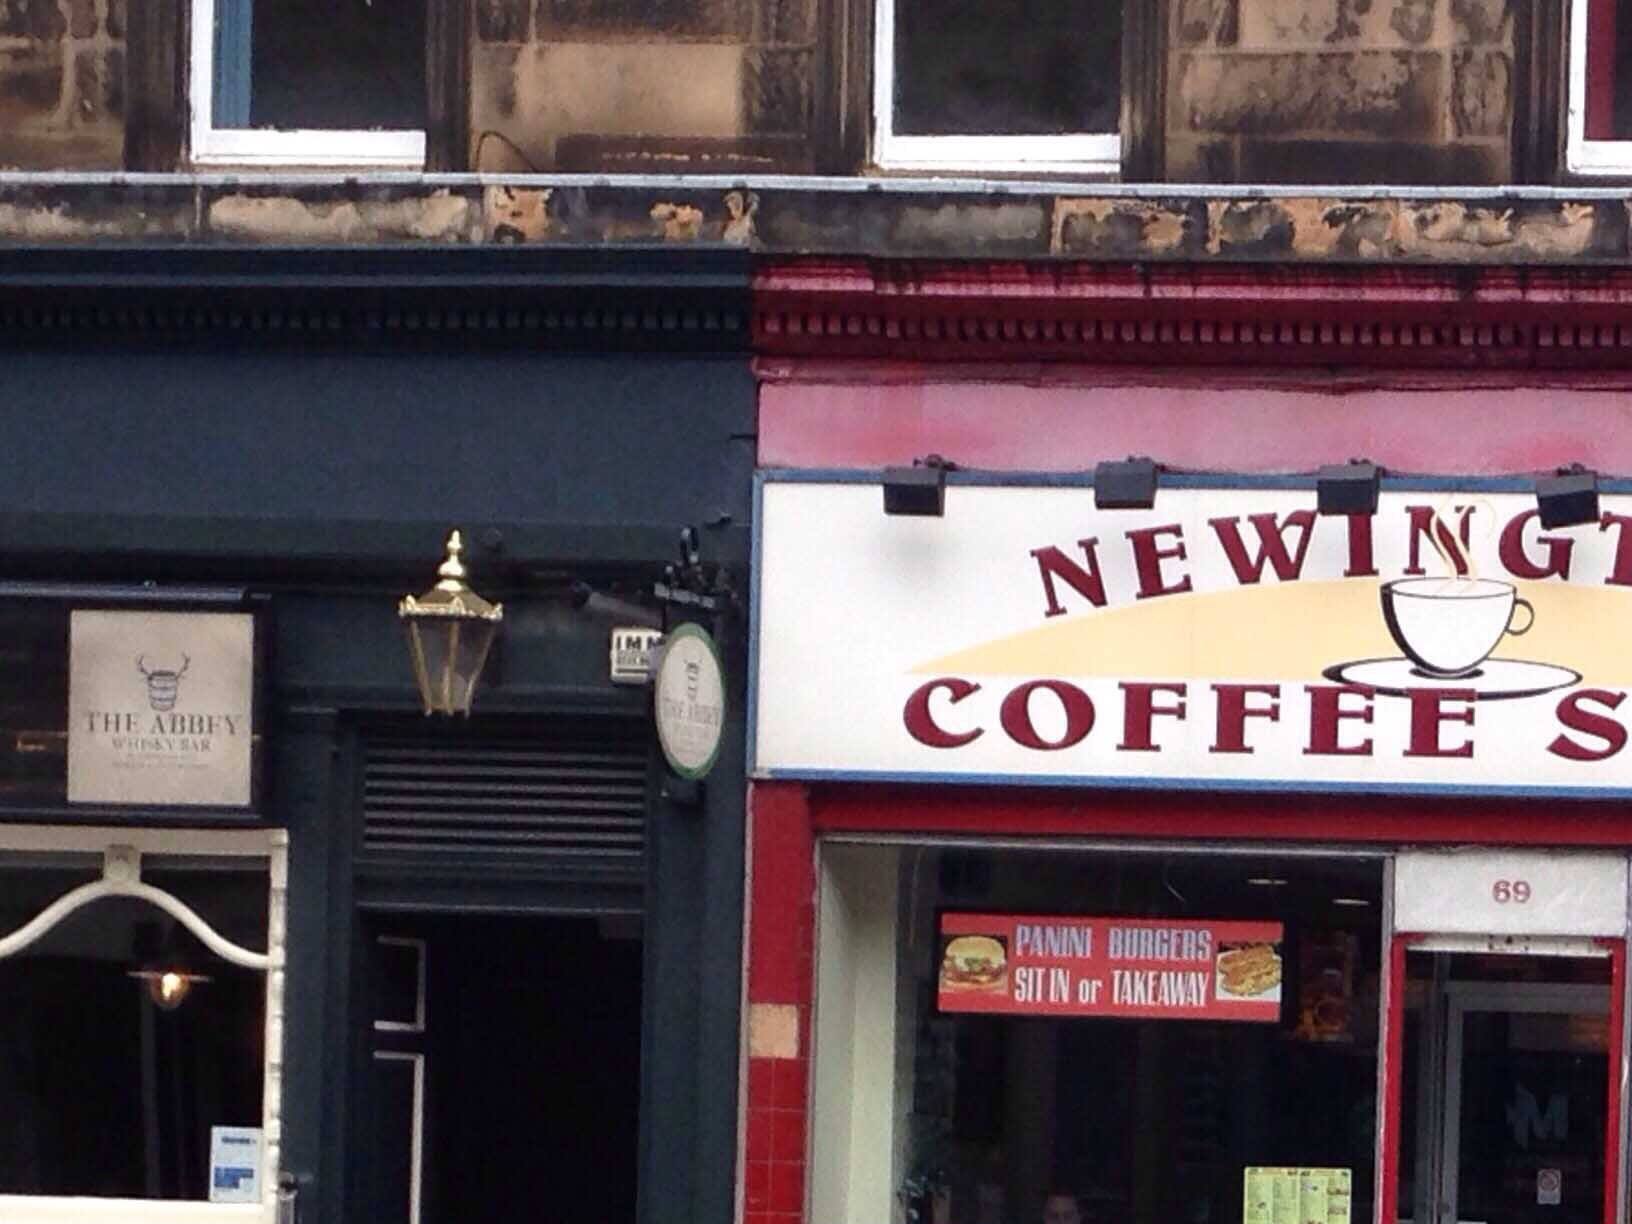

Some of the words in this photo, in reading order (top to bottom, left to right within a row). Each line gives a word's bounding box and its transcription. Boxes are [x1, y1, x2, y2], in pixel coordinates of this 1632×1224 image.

[83, 712, 138, 733] THE
[151, 714, 242, 735] ABBEY
[903, 677, 1476, 758] COFFEE
[1492, 880, 1531, 904] 69
[1015, 924, 1091, 959] PANINI
[1108, 927, 1213, 961] BURGERS
[1014, 967, 1045, 1003] SIT
[1050, 969, 1070, 1004] IN
[1078, 977, 1102, 1004] or
[1112, 970, 1207, 1008] TAKEAWAY
